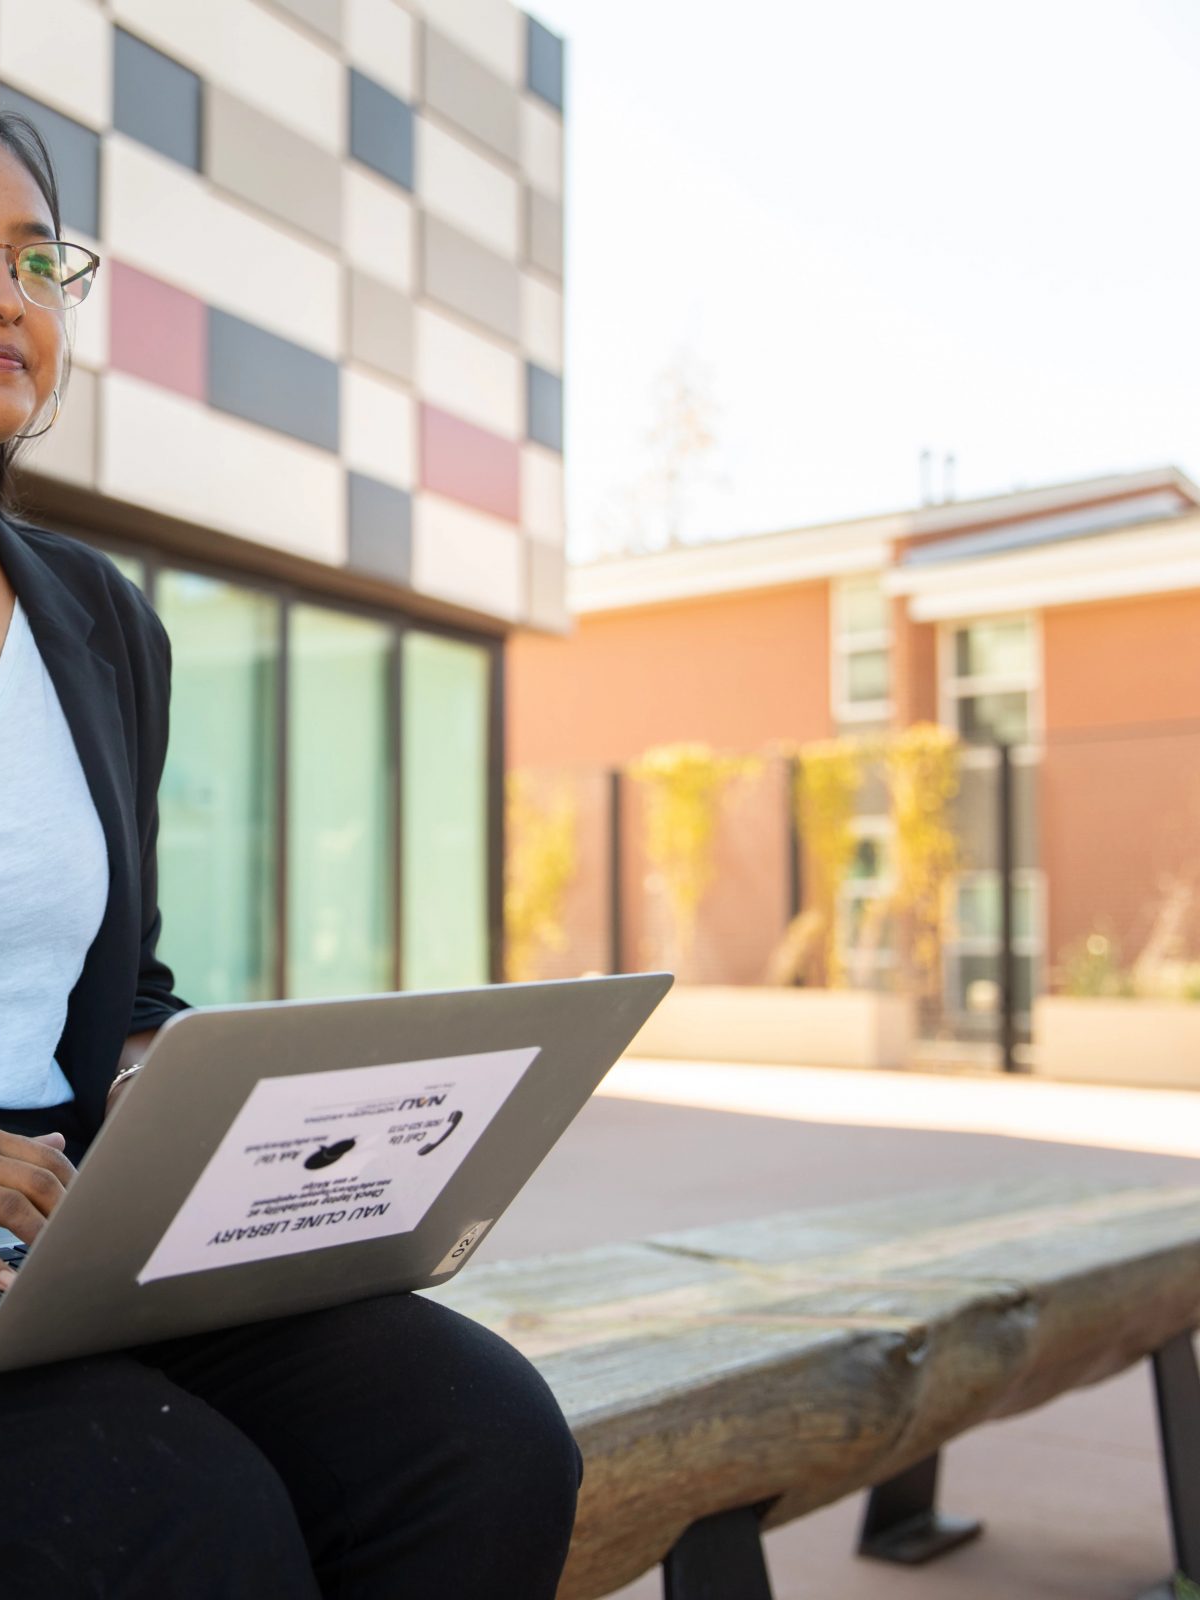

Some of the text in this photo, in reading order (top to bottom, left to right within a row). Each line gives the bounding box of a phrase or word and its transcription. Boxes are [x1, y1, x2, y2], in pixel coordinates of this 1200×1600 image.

[398, 1094, 447, 1112] NAU
[388, 1131, 427, 1145] Call Us
[321, 1193, 353, 1205] laptop
[353, 1188, 384, 1200] Check
[263, 1200, 320, 1216] availability
[208, 1202, 391, 1245] NAU CLINE LIBRARY
